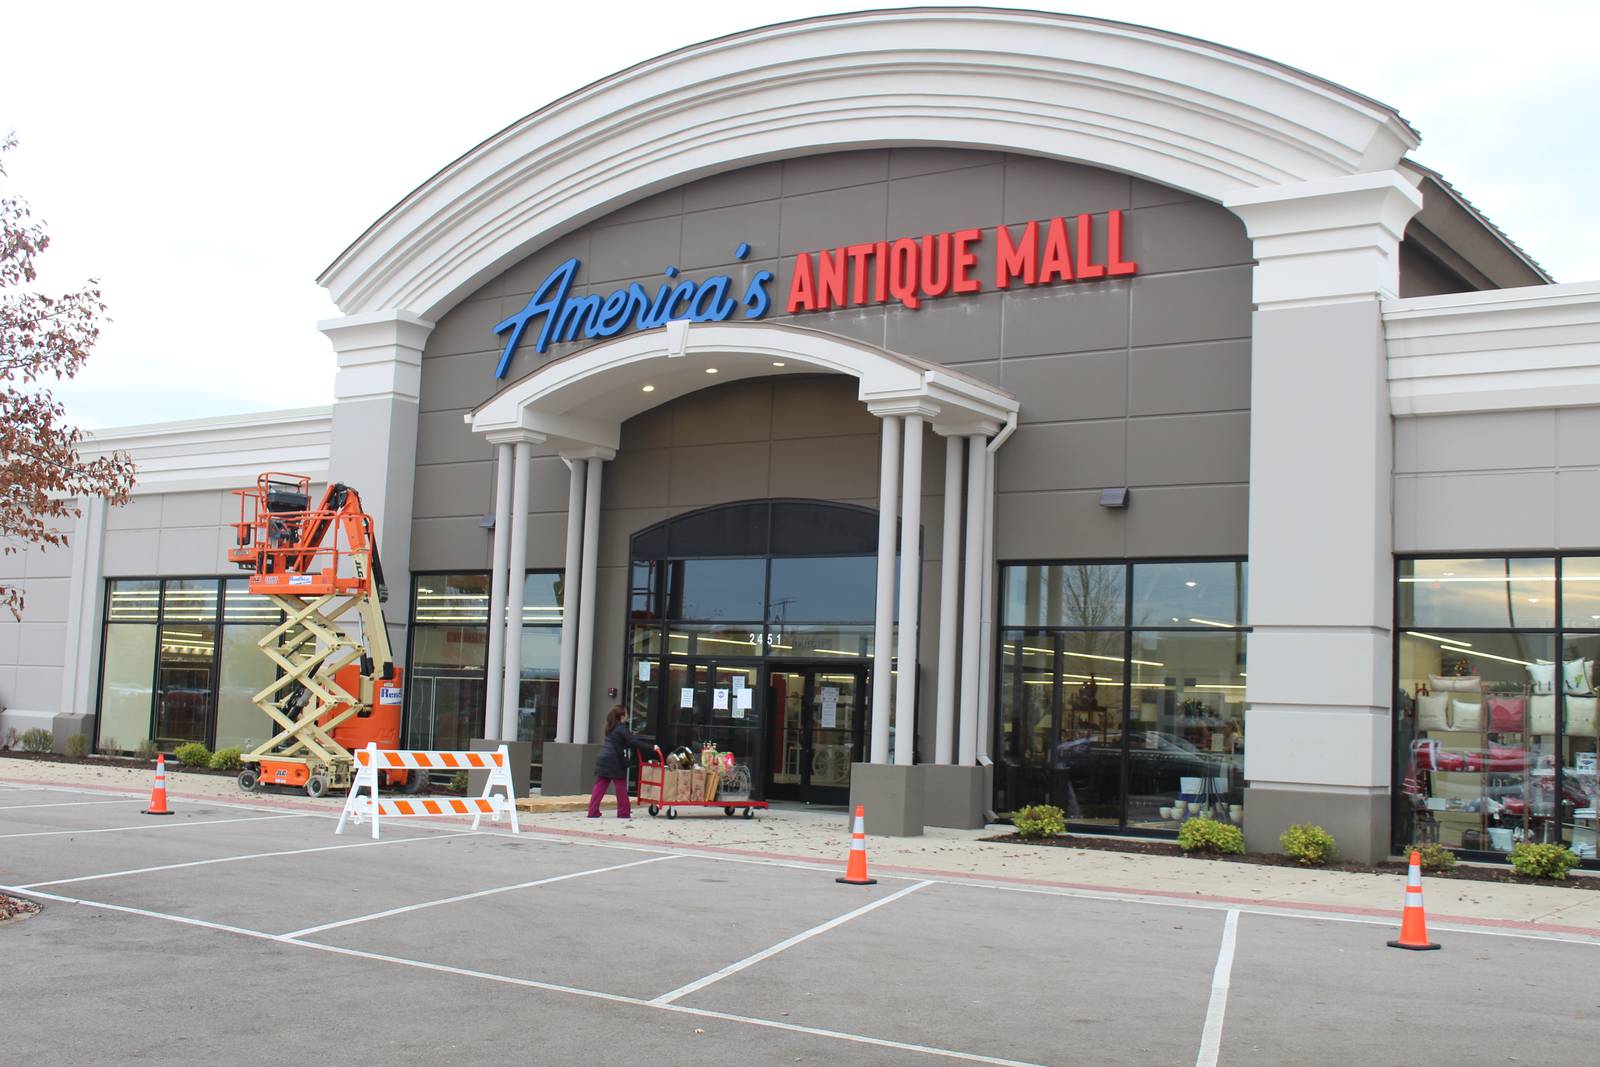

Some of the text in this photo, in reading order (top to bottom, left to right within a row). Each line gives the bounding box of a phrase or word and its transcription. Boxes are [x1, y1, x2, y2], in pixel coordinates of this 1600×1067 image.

[492, 210, 1138, 379] America's ANTIQUE MALL
[749, 632, 781, 645] 2451
